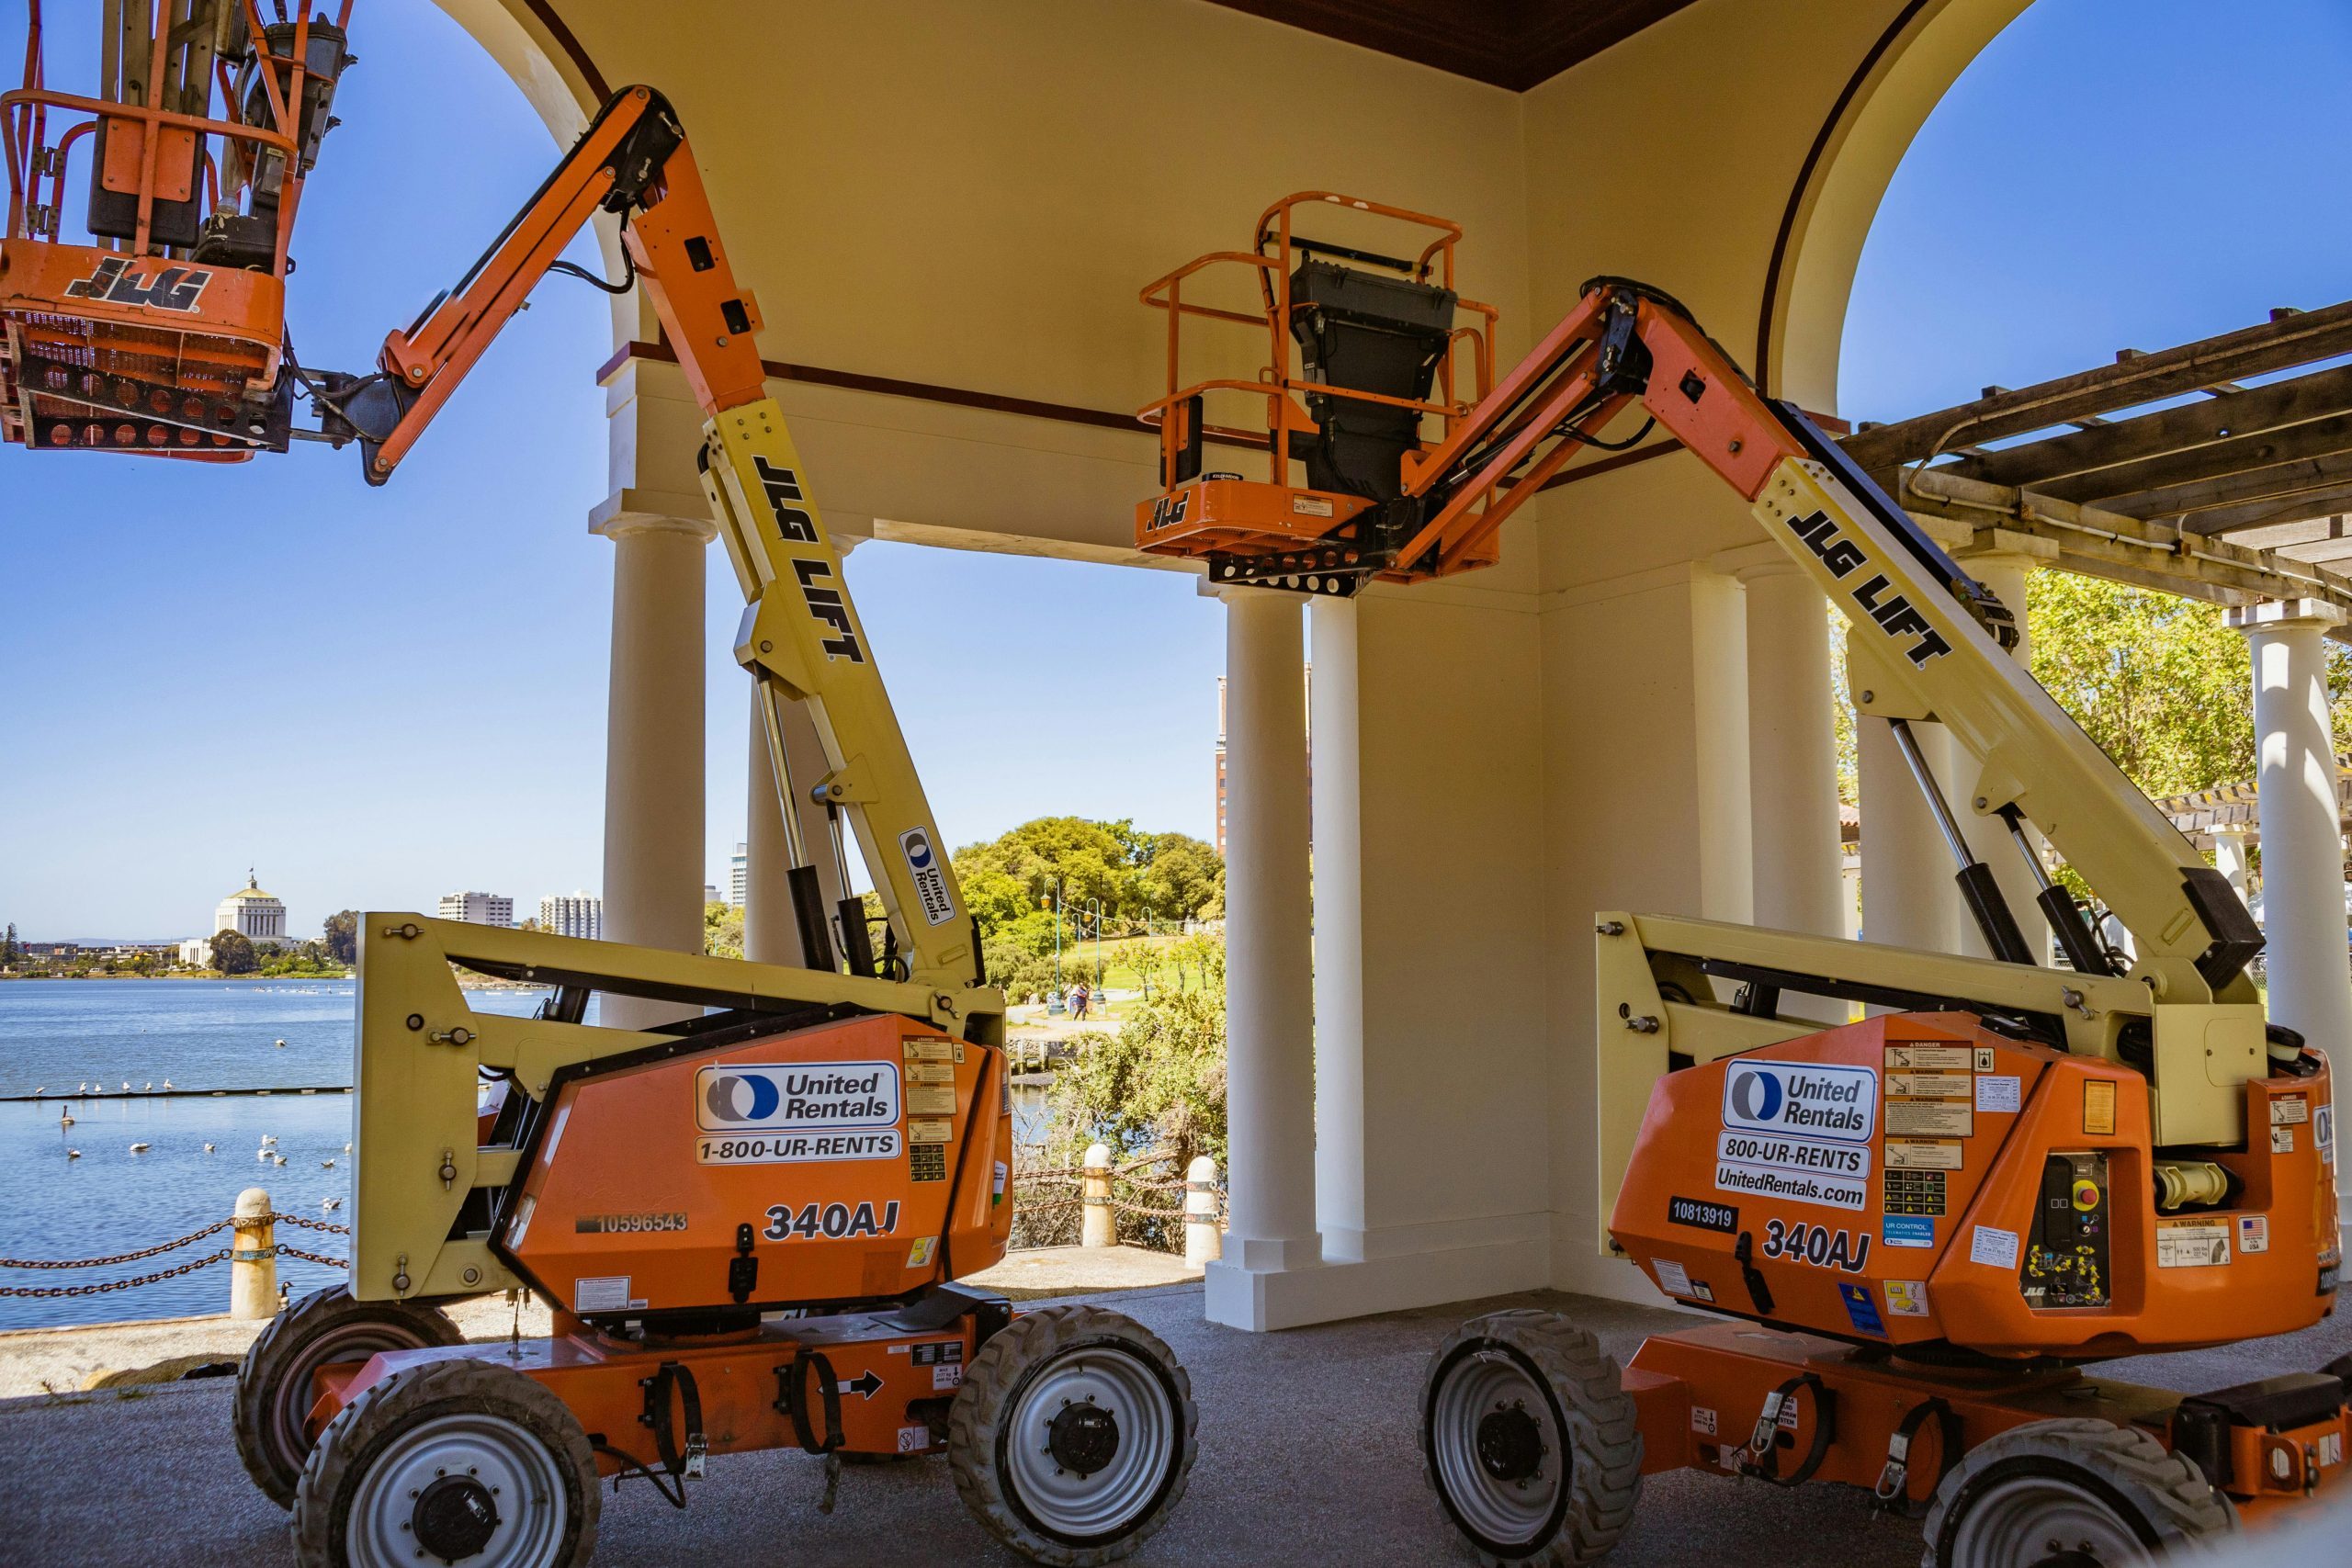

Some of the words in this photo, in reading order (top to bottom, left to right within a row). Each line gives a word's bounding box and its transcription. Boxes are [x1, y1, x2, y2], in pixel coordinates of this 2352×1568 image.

[64, 256, 213, 313] JLG
[1146, 490, 1191, 533] JLG
[751, 455, 821, 545] JLG
[790, 558, 865, 664] LIFT
[1785, 509, 1870, 581] JLG
[1849, 572, 1954, 665] LIFT
[915, 872, 939, 920] Rentals
[926, 867, 951, 913] United
[786, 1072, 879, 1096] United
[1787, 1075, 1861, 1103] United
[786, 1096, 888, 1120] Rentals
[1783, 1100, 1865, 1131] Rentals
[700, 1135, 894, 1159] 1-800-UR-RENTS
[1725, 1138, 1861, 1171] 800-UR-RENTS
[1717, 1168, 1863, 1204] UnitedRentals.com
[597, 1213, 687, 1233] 10596543
[762, 1200, 900, 1242] 340AJ
[1673, 1201, 1732, 1227] 10813919
[1895, 1223, 1927, 1231] CONTROL
[2179, 1219, 2216, 1228] WARNING
[1761, 1218, 1871, 1274] 340AJ
[2024, 1287, 2046, 1297] JLG
